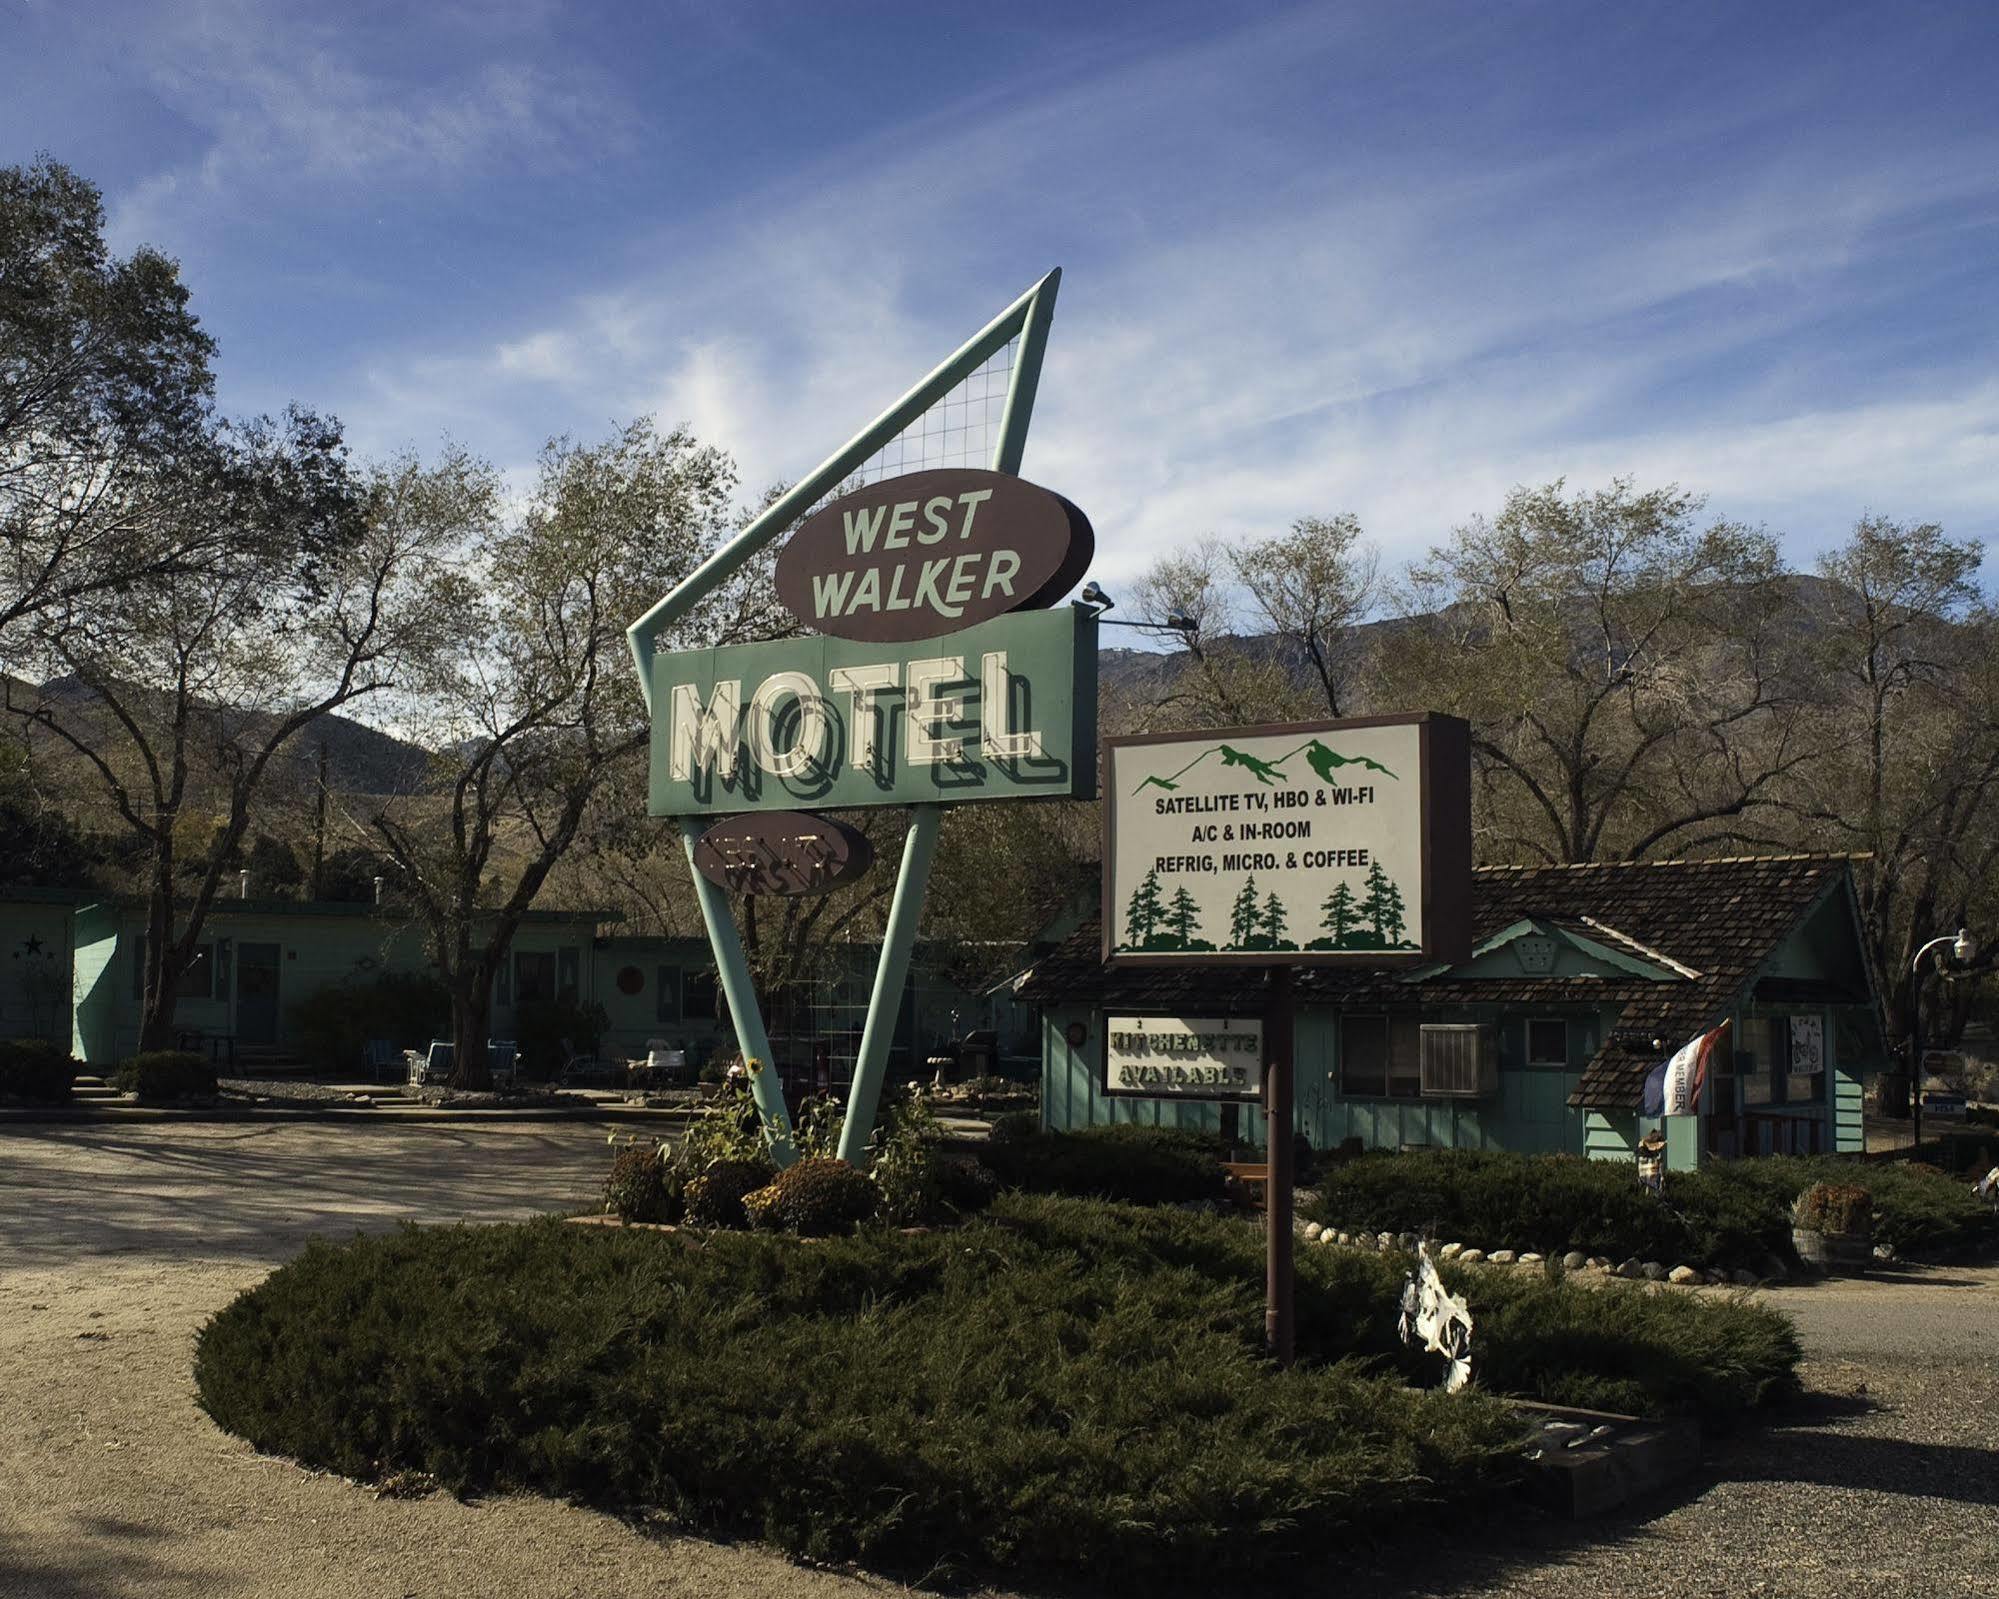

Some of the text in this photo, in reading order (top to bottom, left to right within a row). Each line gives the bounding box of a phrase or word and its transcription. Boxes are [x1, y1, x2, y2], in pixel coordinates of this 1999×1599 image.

[842, 489, 993, 556] WEST
[812, 549, 1022, 619] WALKER
[670, 650, 1042, 782] MOTEL
[1155, 787, 1375, 815] SATELLITE TV, HBO & WI-FI
[1191, 821, 1311, 843] A/C & IN-ROOM
[1155, 849, 1369, 875] REFRIG, MICRO. & COFFEE
[1118, 1064, 1248, 1087] AVAILABLE
[1674, 1063, 1685, 1113] MEMBER
